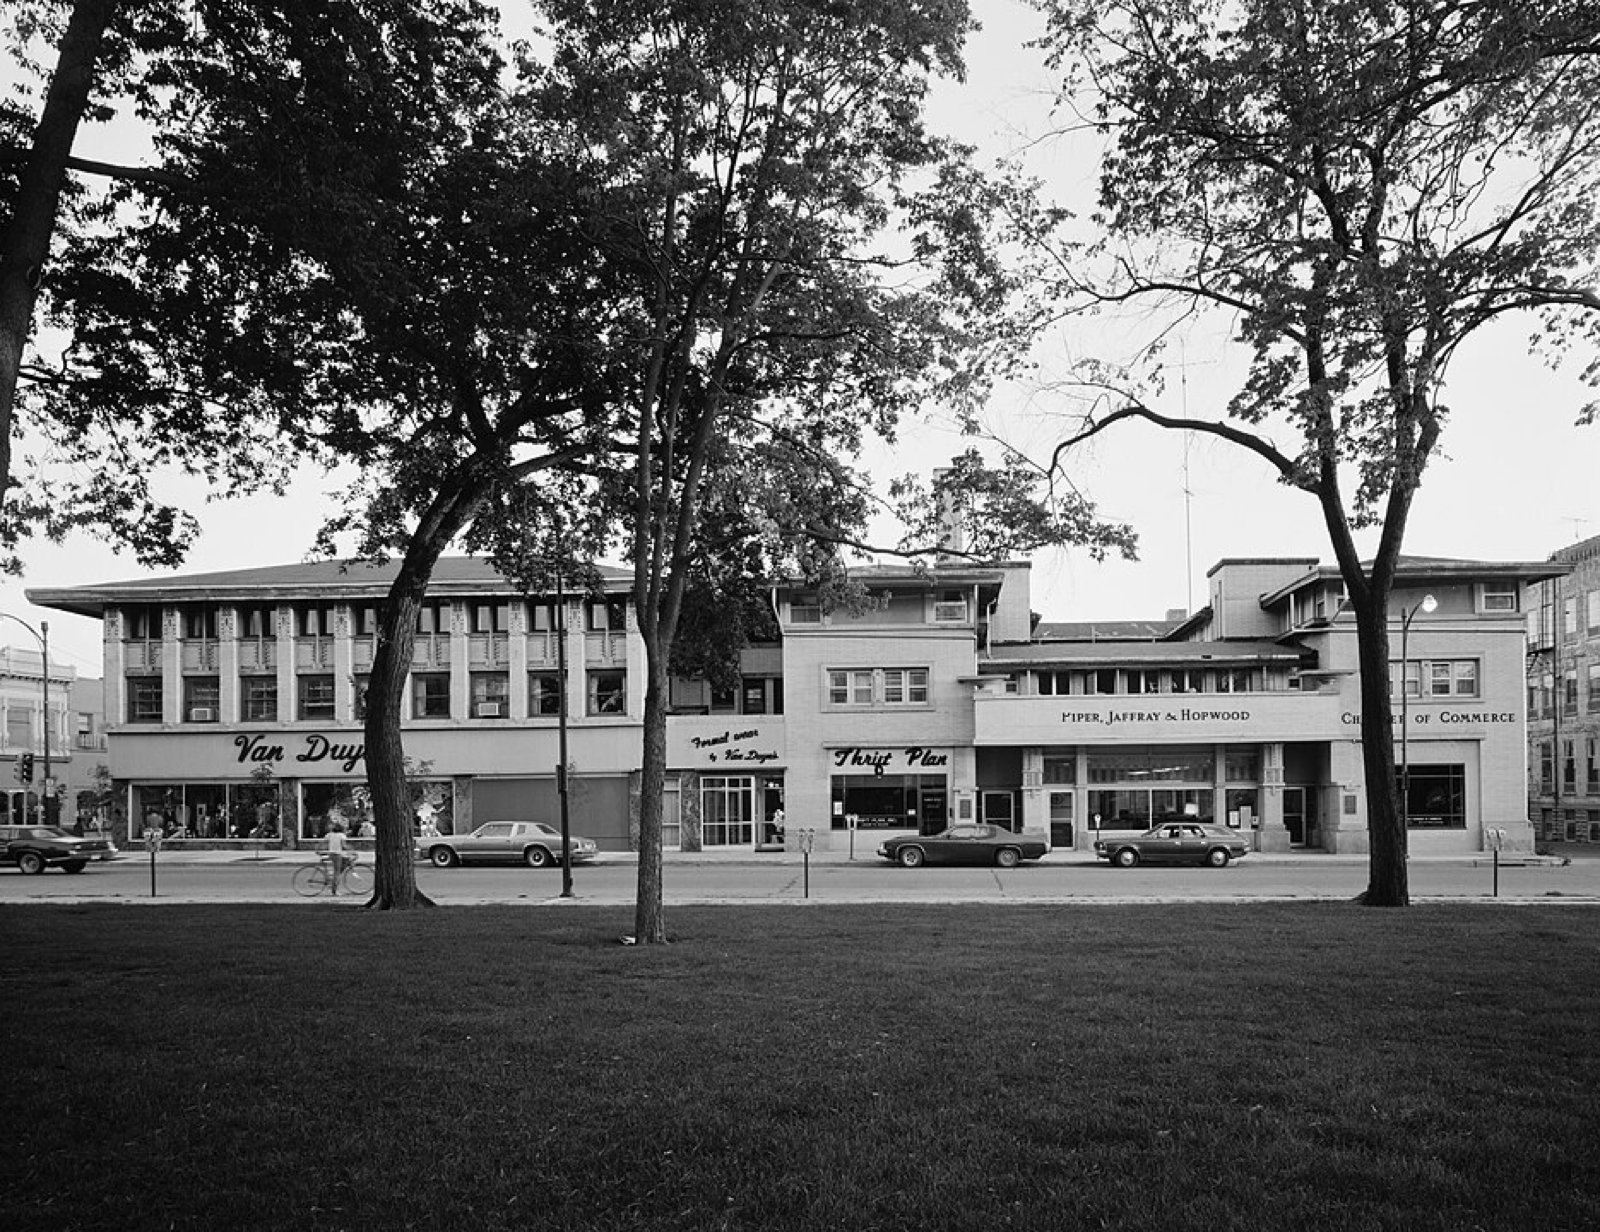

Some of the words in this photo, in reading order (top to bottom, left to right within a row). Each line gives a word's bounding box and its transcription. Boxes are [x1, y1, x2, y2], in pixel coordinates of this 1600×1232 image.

[1105, 710, 1161, 726] JAFFRAY
[1164, 712, 1177, 721] &
[1181, 708, 1250, 721] HOPWOOD
[1414, 714, 1431, 724] OF
[1440, 711, 1515, 724] COMMERCE
[234, 735, 284, 763] Van
[834, 748, 892, 776] Thrift
[905, 747, 948, 767] Plan
